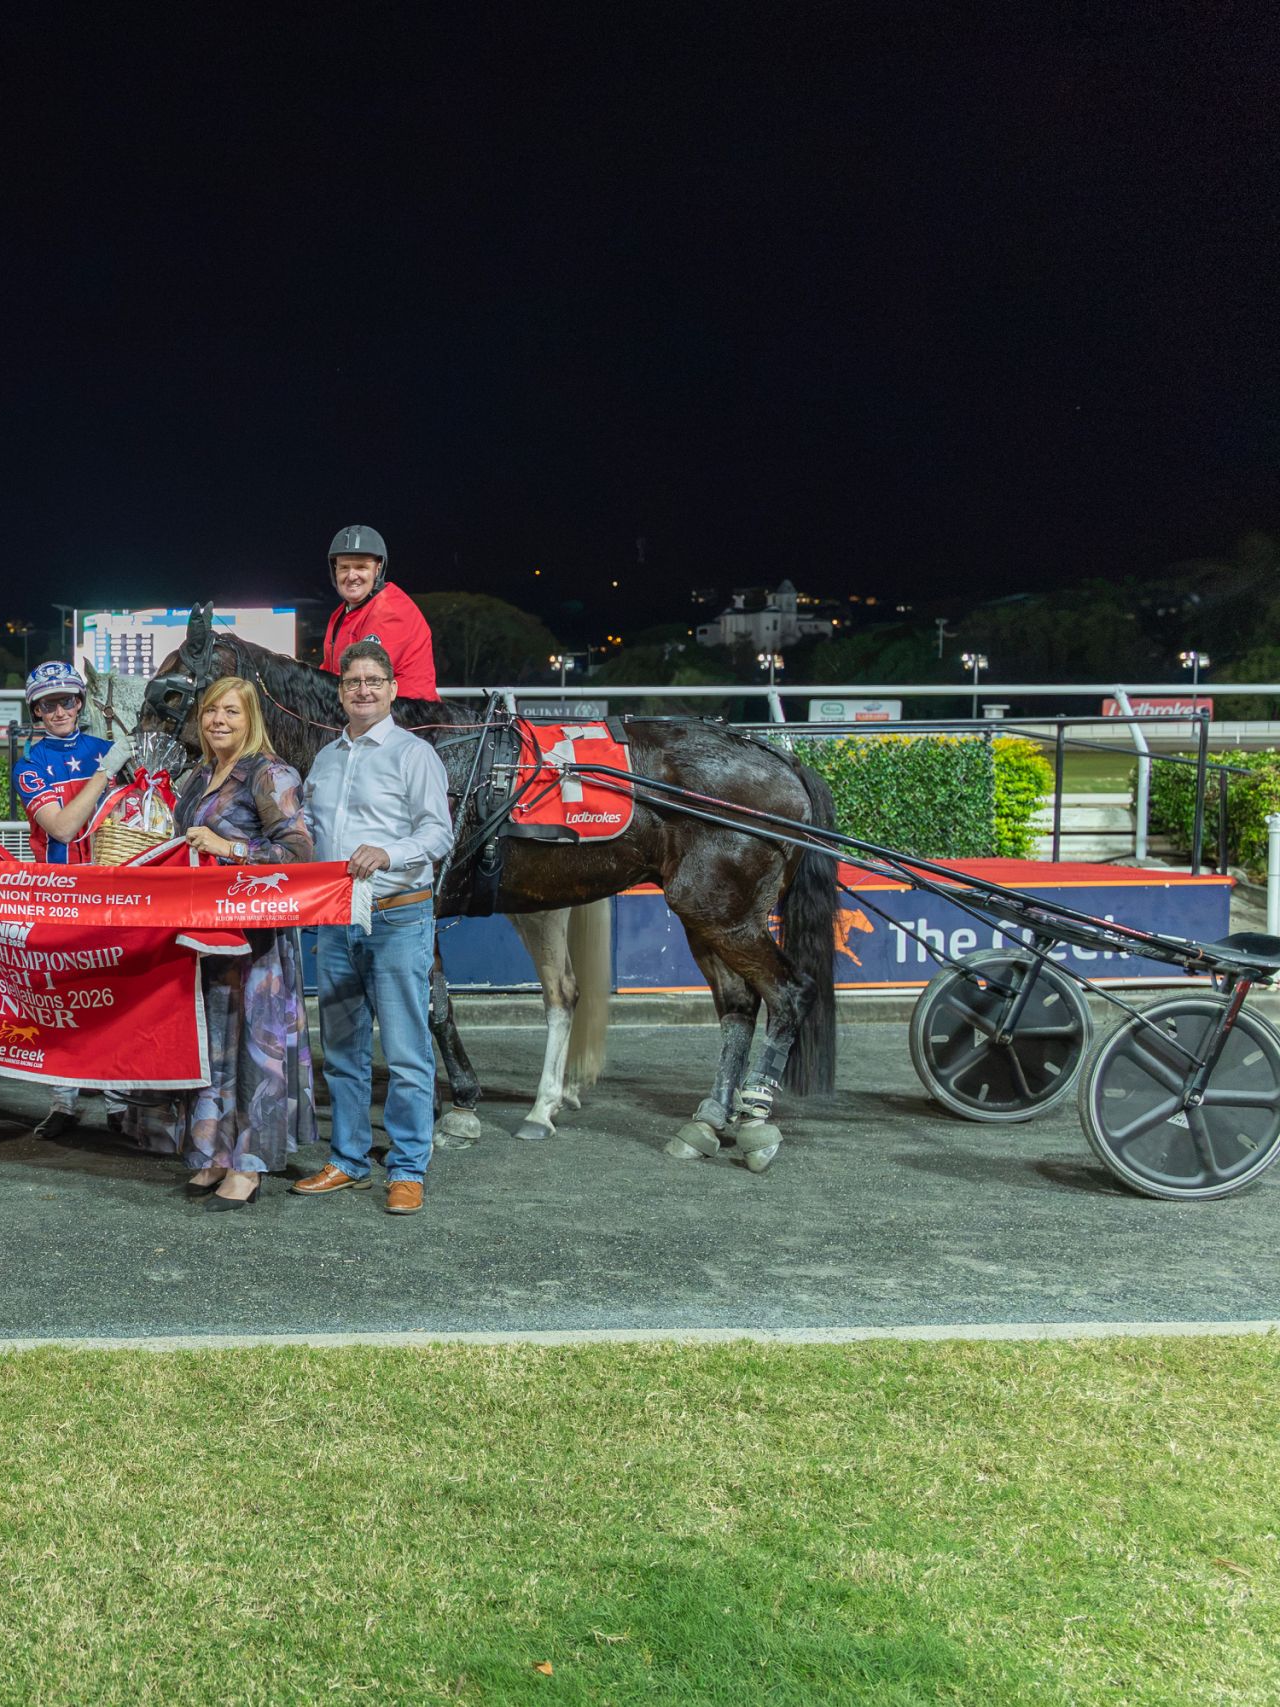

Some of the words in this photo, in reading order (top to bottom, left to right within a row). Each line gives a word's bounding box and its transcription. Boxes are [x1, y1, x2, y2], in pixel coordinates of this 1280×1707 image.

[1108, 702, 1204, 716] Ldbrokes
[19, 771, 46, 793] G
[565, 812, 621, 824] Ladbrokes
[34, 891, 102, 904] TROTTING
[106, 894, 141, 905] HEAT
[145, 895, 151, 905] 1
[216, 899, 246, 914] The
[250, 897, 299, 913] Creek
[49, 906, 79, 918] 2026
[888, 918, 977, 963] The
[44, 972, 56, 990] 1
[67, 987, 115, 1009] 2026
[9, 1046, 45, 1062] Creek
